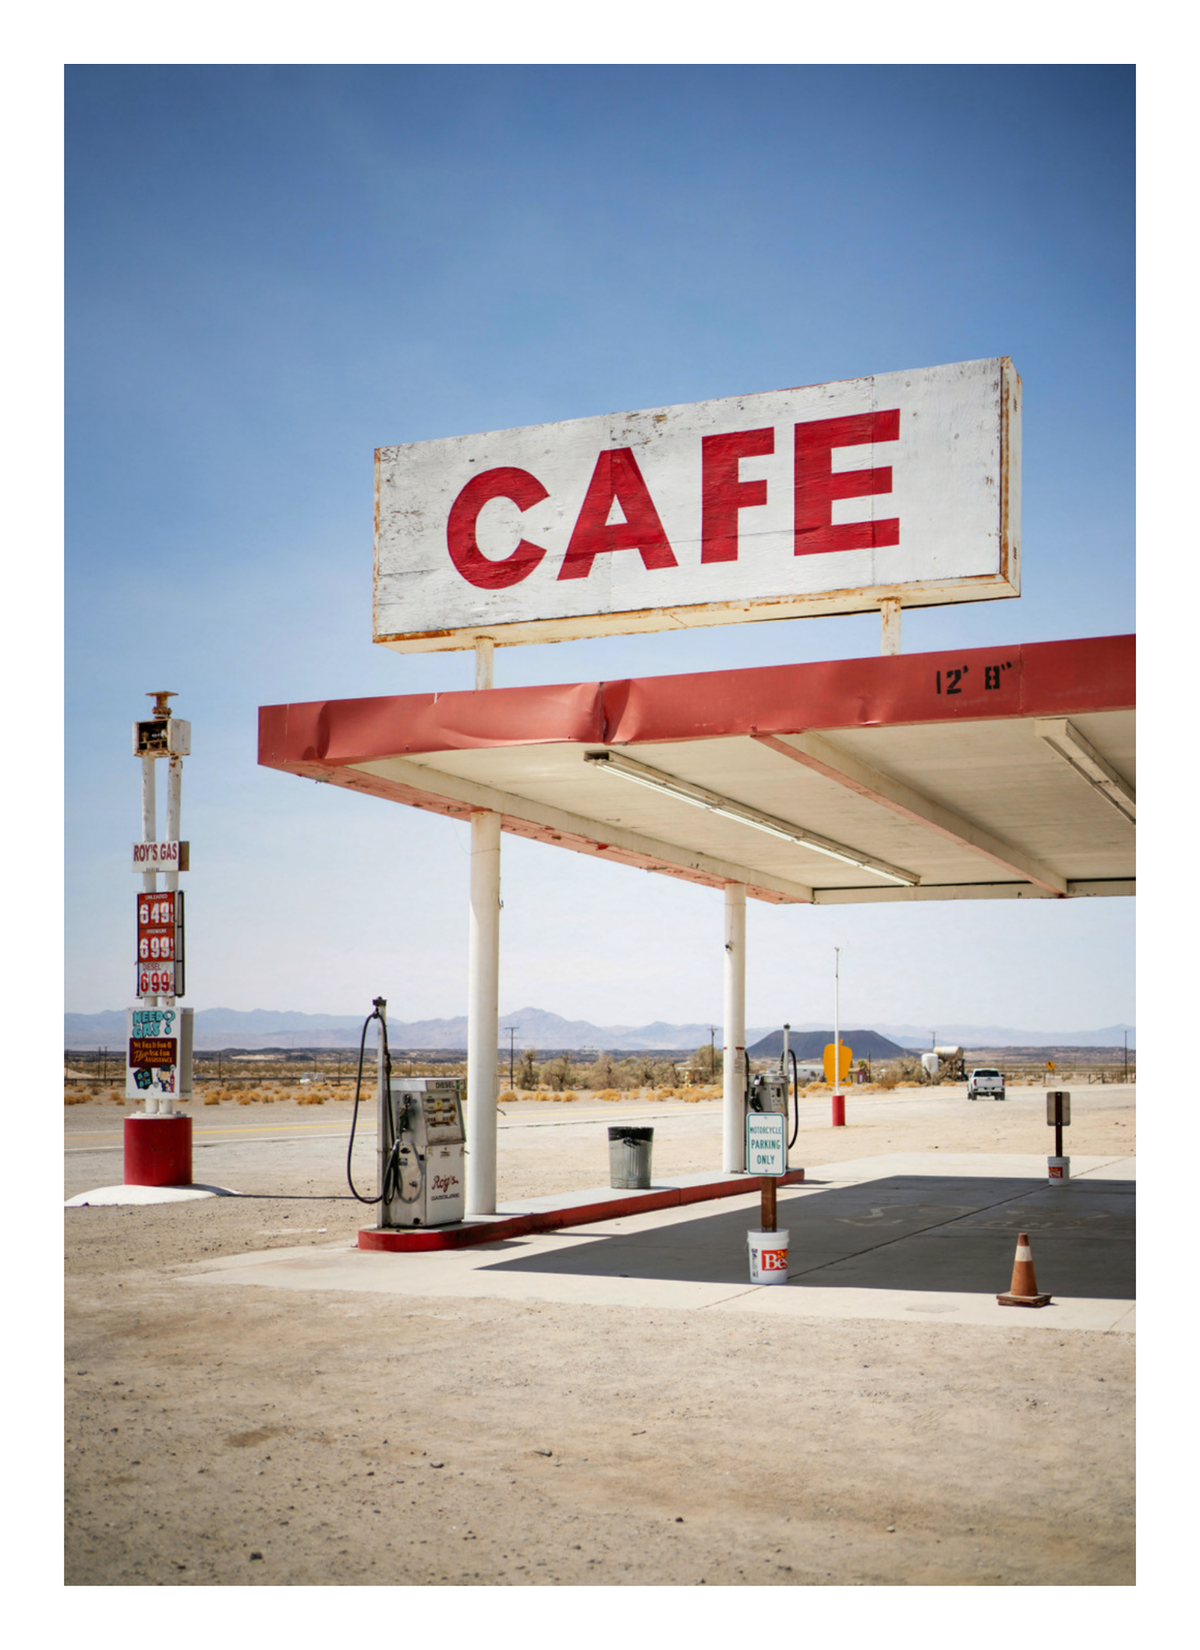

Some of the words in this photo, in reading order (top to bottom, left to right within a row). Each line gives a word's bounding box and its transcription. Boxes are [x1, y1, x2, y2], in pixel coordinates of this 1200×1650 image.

[447, 408, 900, 589] CAFE
[936, 665, 969, 695] 12'
[133, 844, 158, 862] ROY'S
[160, 843, 177, 860] GAS
[142, 962, 161, 971] DIESEL
[435, 1081, 455, 1089] DIESEL
[751, 1139, 781, 1149] PARKING
[757, 1155, 775, 1165] ONLY
[431, 1193, 460, 1201] GASOLINE
